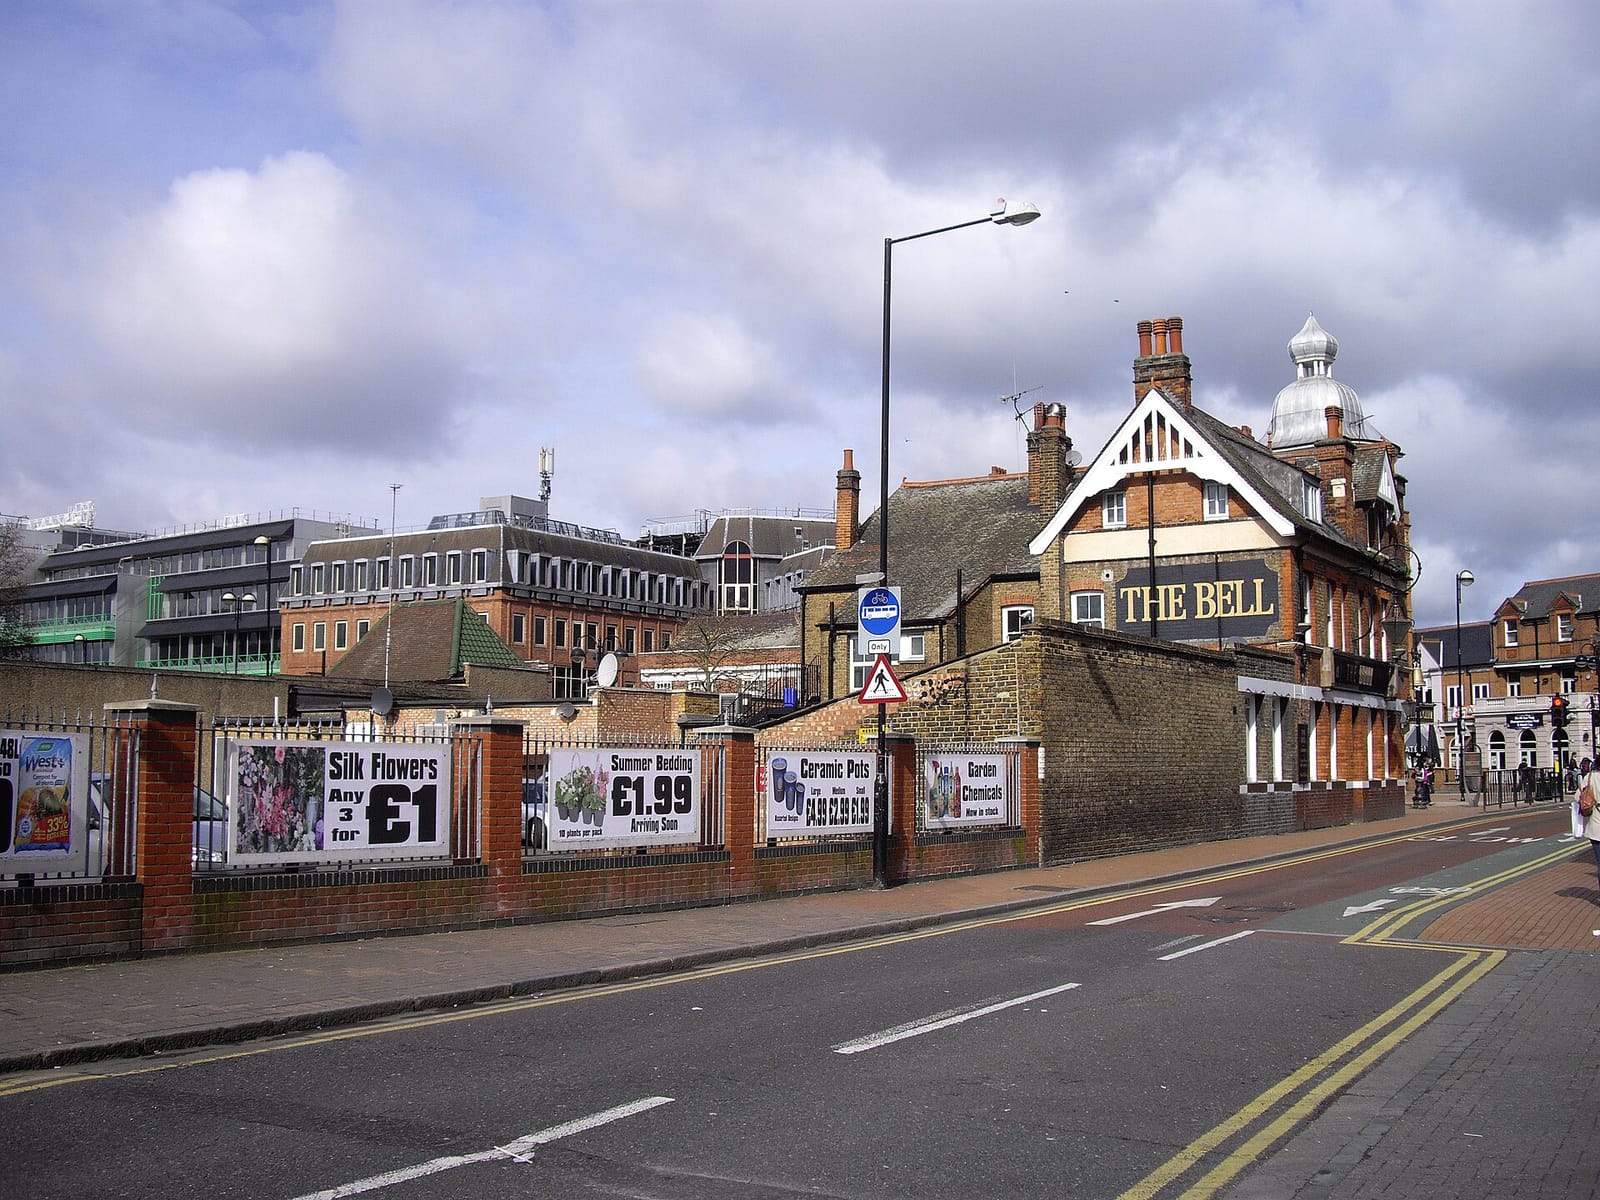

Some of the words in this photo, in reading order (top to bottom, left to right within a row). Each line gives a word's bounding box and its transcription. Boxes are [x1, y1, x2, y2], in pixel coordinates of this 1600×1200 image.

[1120, 584, 1187, 623] THE
[1193, 578, 1274, 619] BELL
[871, 643, 887, 652] Only
[329, 752, 364, 780] Silk
[371, 752, 438, 780] Flowers
[611, 754, 653, 772] Summer
[656, 754, 693, 774] Bedding
[800, 758, 844, 779] Ceramic
[847, 759, 870, 779] Pots
[968, 762, 997, 778] Garden
[328, 788, 364, 804] Any
[611, 775, 692, 816] £1.99
[811, 786, 821, 797] Large
[832, 787, 845, 795] Medium
[856, 786, 866, 795] Small
[962, 784, 1003, 802] Chemicals
[339, 808, 353, 822] 3
[365, 784, 437, 844] £1
[806, 797, 827, 827] £4.99
[829, 797, 849, 826] £2.99
[851, 797, 870, 825] £1.99
[965, 807, 977, 817] Now
[978, 807, 984, 817] in
[985, 806, 999, 816] stock
[47, 815, 69, 833] 33%
[631, 817, 660, 834] Arriving
[661, 817, 678, 832] Soon
[331, 828, 360, 842] for
[559, 829, 565, 837] 10
[566, 829, 581, 838] plants
[582, 829, 590, 837] per
[592, 828, 602, 837] pack
